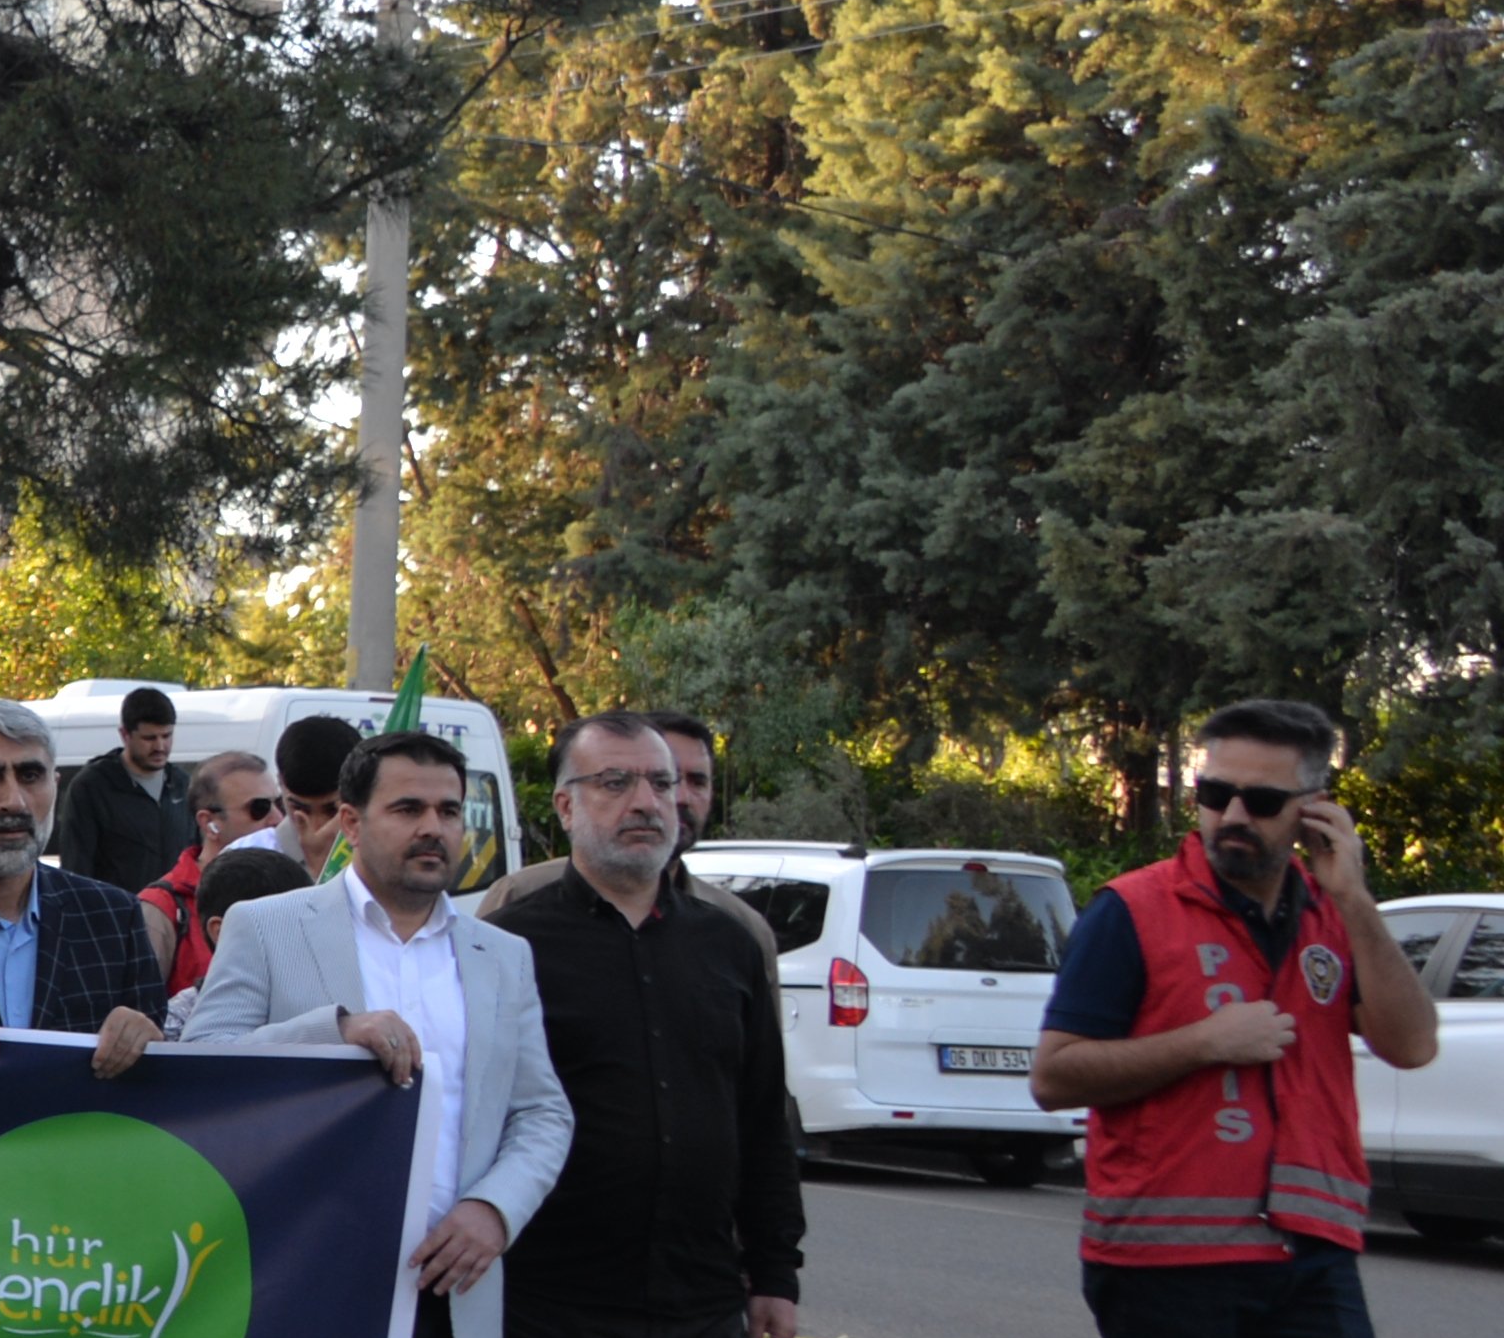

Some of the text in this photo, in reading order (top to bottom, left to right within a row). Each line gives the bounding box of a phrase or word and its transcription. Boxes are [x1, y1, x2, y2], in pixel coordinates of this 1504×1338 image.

[950, 1050, 967, 1067] 06
[1196, 942, 1254, 1143] POIS
[11, 1218, 103, 1269] hür
